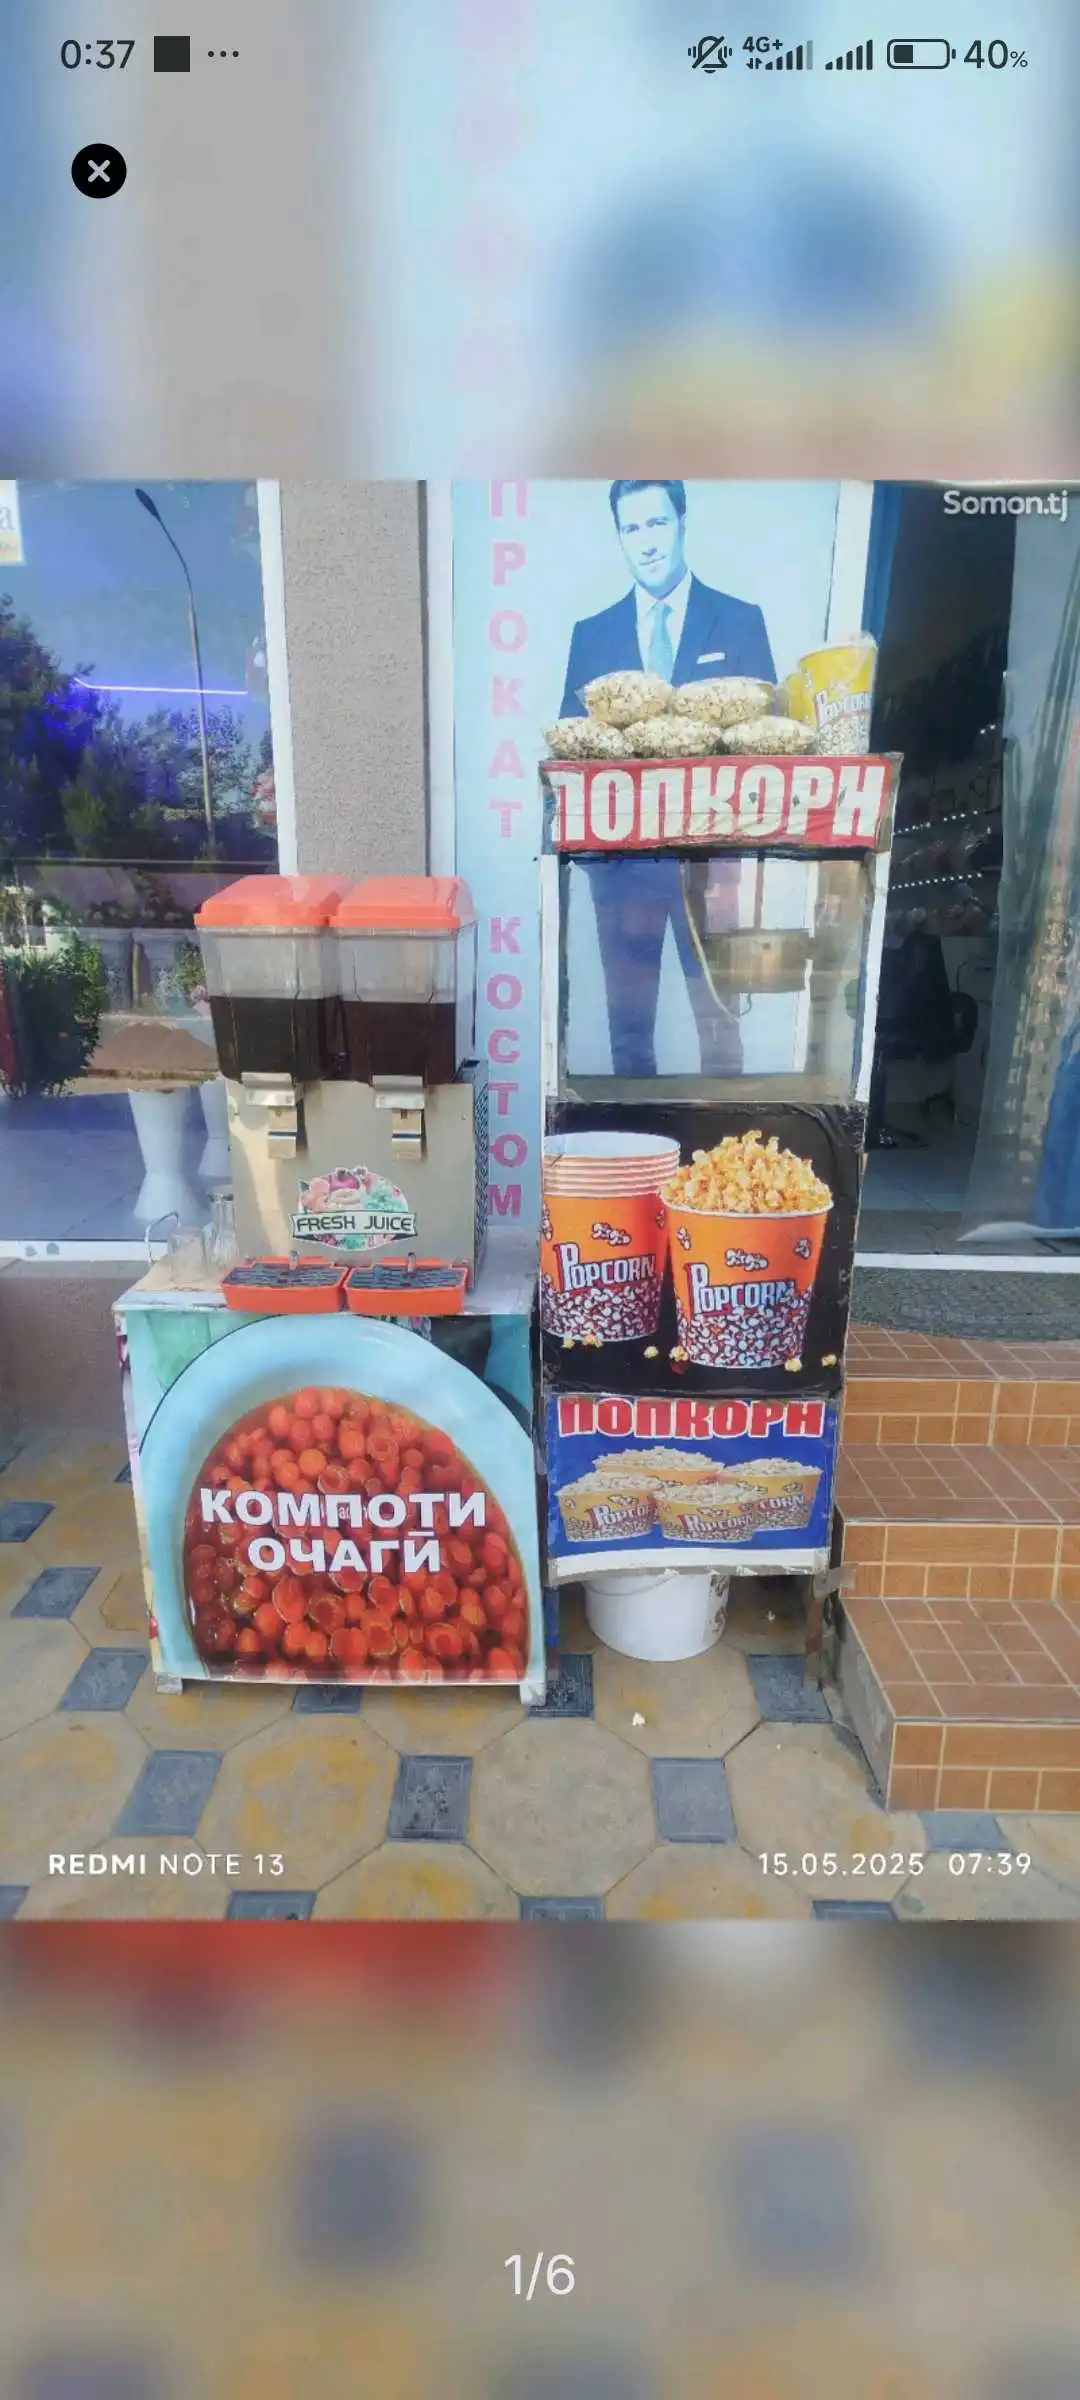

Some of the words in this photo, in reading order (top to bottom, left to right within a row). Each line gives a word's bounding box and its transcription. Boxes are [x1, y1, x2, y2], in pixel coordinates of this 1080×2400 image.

[488, 479, 529, 838] ПРОКАТ
[548, 764, 886, 842] ПОПКОРН
[486, 916, 528, 1218] КОСТОМ
[296, 1214, 355, 1232] FRESH
[363, 1215, 412, 1232] JUICE
[558, 1394, 825, 1439] ПОПКОРН
[199, 1487, 486, 1528] КОМПОТИ
